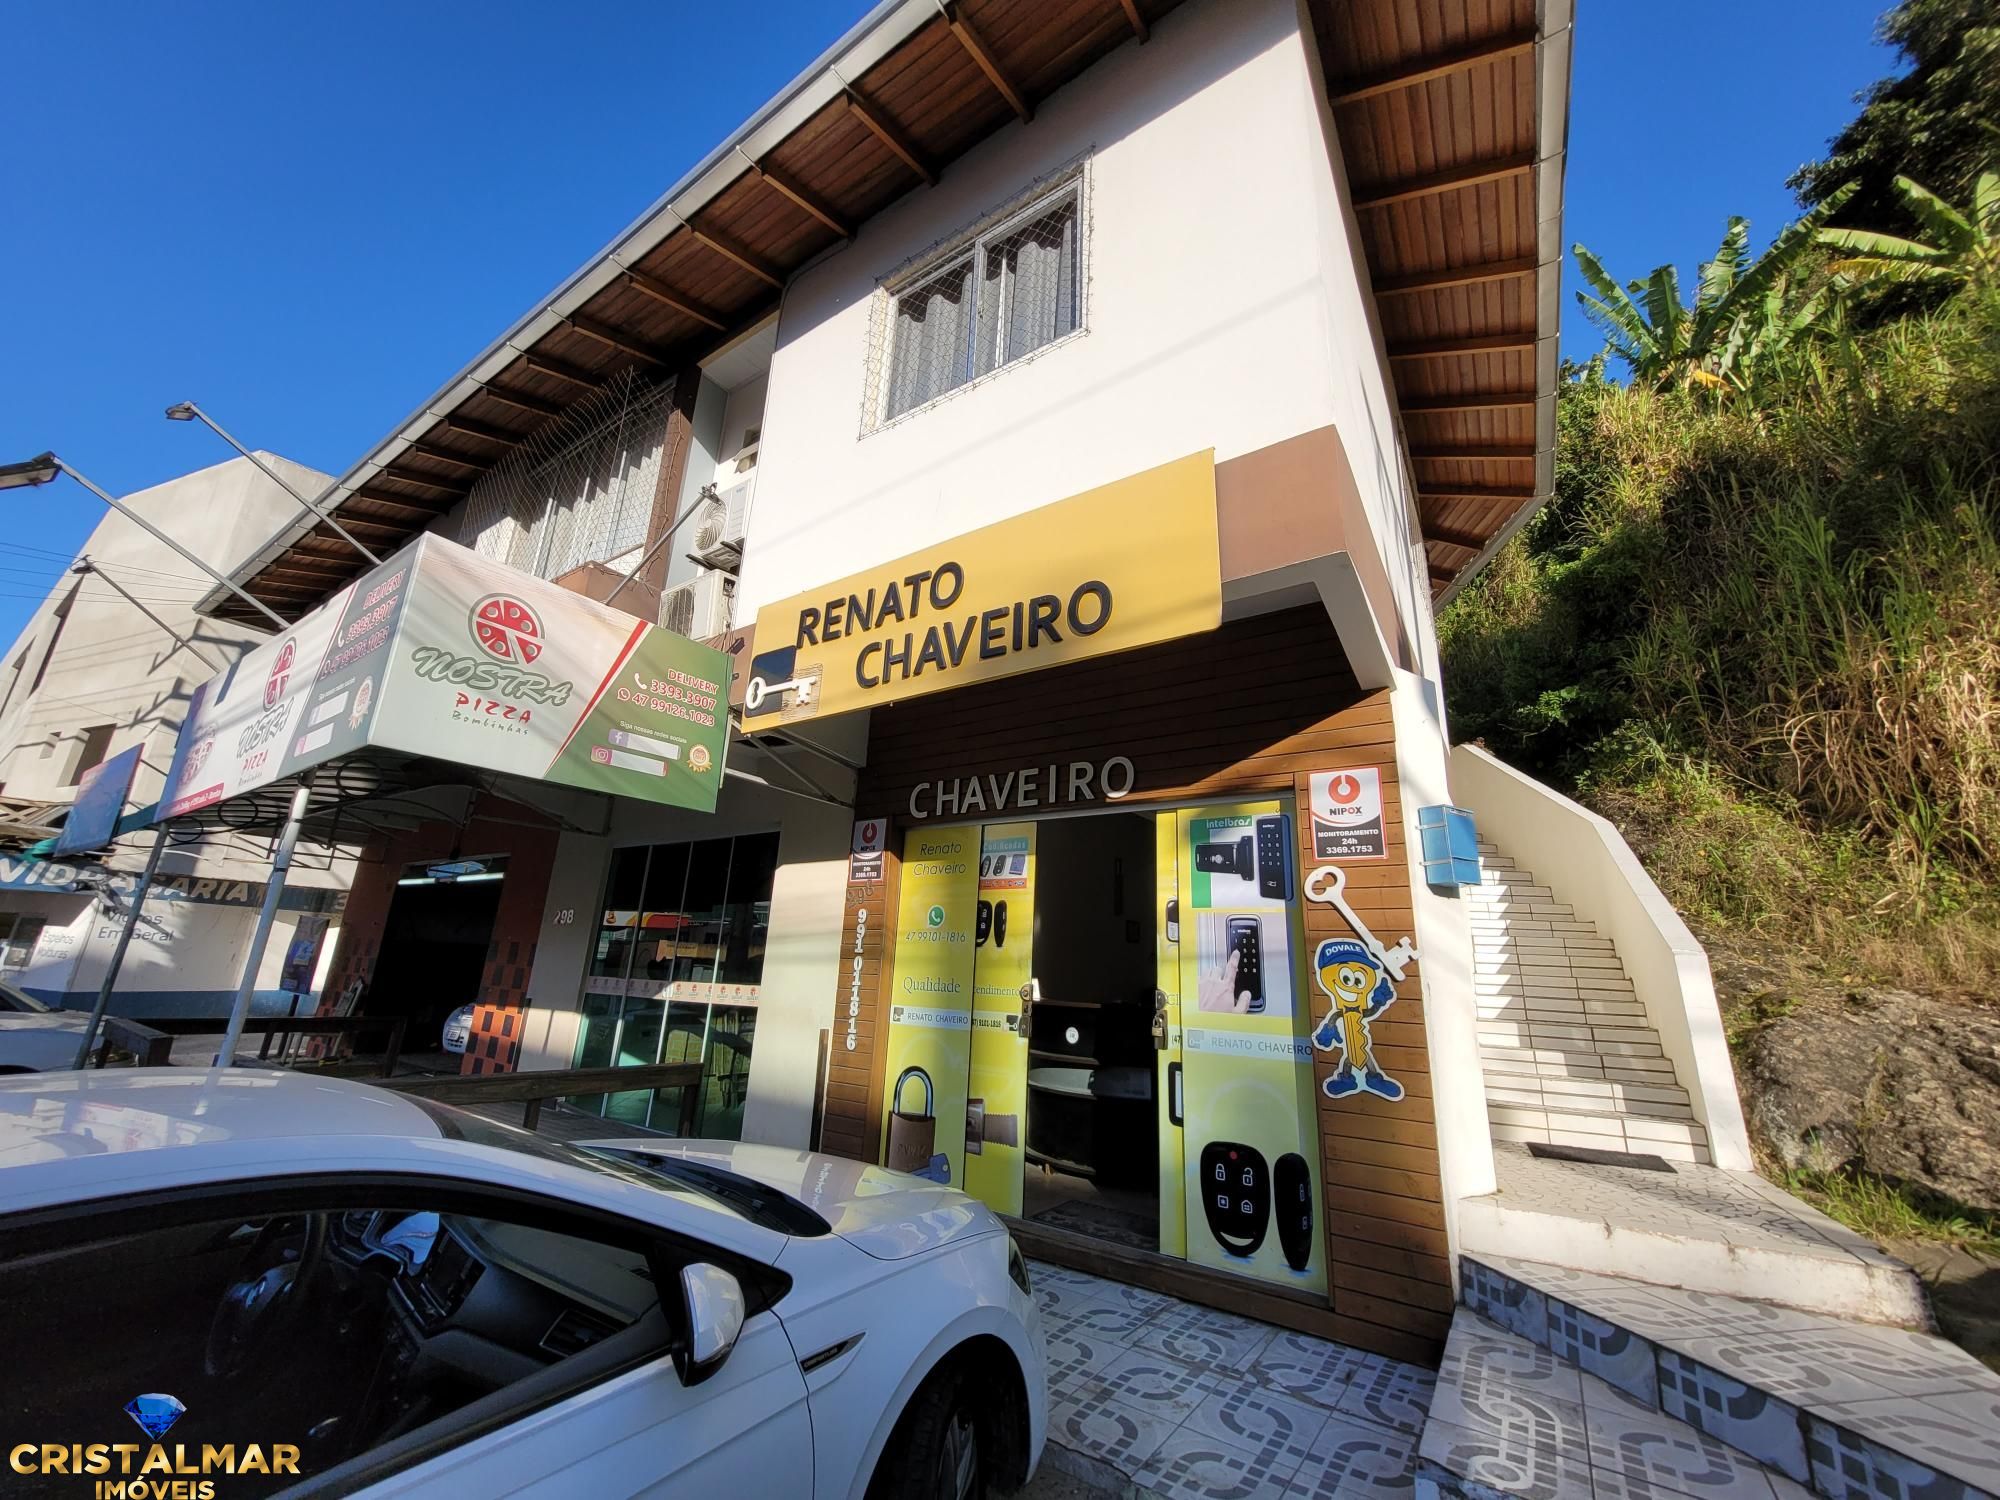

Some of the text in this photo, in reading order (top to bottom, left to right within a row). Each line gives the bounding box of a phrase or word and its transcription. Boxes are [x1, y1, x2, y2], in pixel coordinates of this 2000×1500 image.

[796, 561, 965, 649] RENATO
[855, 580, 1114, 690] CHAVEIRO
[668, 669, 719, 695] DELIVERY
[650, 679, 717, 712] 3393.3907
[455, 692, 532, 724] PIZZA
[632, 692, 715, 727] 47 99126.1023
[451, 710, 529, 736] Bombinhas
[620, 720, 633, 731] Siga
[242, 749, 269, 773] PIZZA
[909, 756, 1135, 819] CHAVEIRO
[1329, 806, 1362, 816] NIPOX
[1206, 818, 1251, 829] intelbras
[1317, 829, 1379, 838] MONITORAMENTO
[919, 842, 962, 856] Renato
[1326, 845, 1373, 854] 3369.1753
[913, 863, 967, 876] Chaveiro
[130, 928, 175, 942] Geral
[918, 931, 966, 943] 99101-1816
[1325, 944, 1362, 957] DOVALE
[903, 976, 961, 993] Qualidade
[974, 983, 1020, 996] endimento
[907, 1012, 969, 1025] RENATO CHAVEIRO
[1211, 1036, 1313, 1056] RENATO CHAVEIRO
